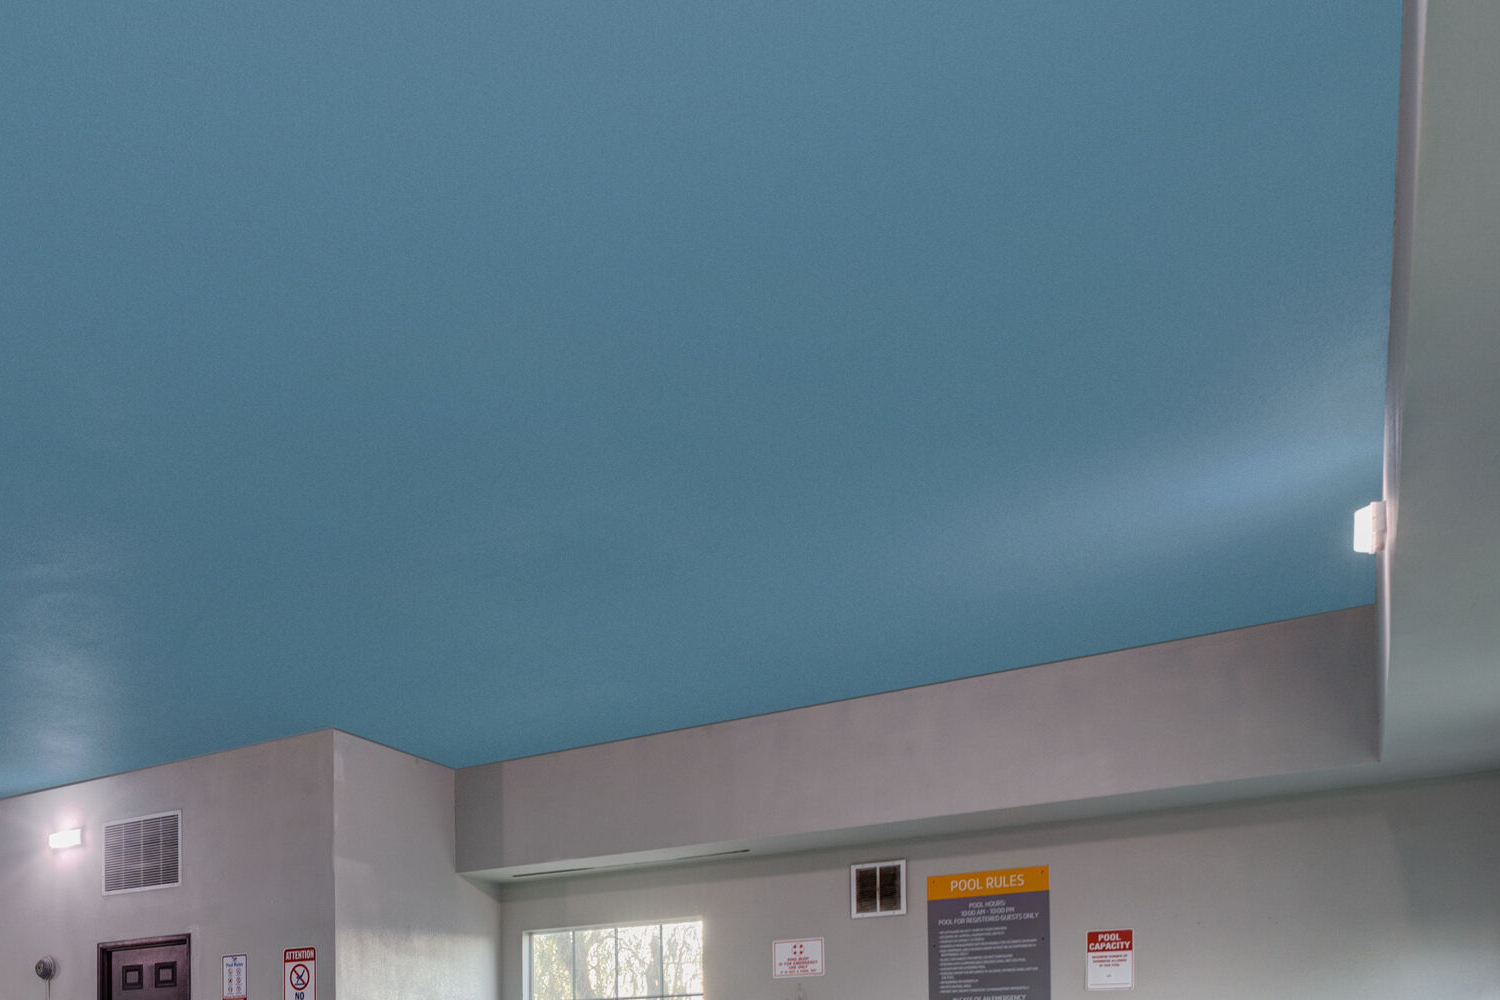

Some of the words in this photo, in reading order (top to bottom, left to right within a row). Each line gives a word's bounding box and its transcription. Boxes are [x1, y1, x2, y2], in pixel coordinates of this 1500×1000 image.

[950, 878, 983, 892] POOL
[986, 874, 1025, 889] RULES
[968, 901, 983, 909] POOL
[1098, 933, 1121, 942] POOL
[1089, 941, 1131, 950] CAPACITY
[286, 949, 314, 960] ATTENTION
[295, 991, 305, 1000] NO
